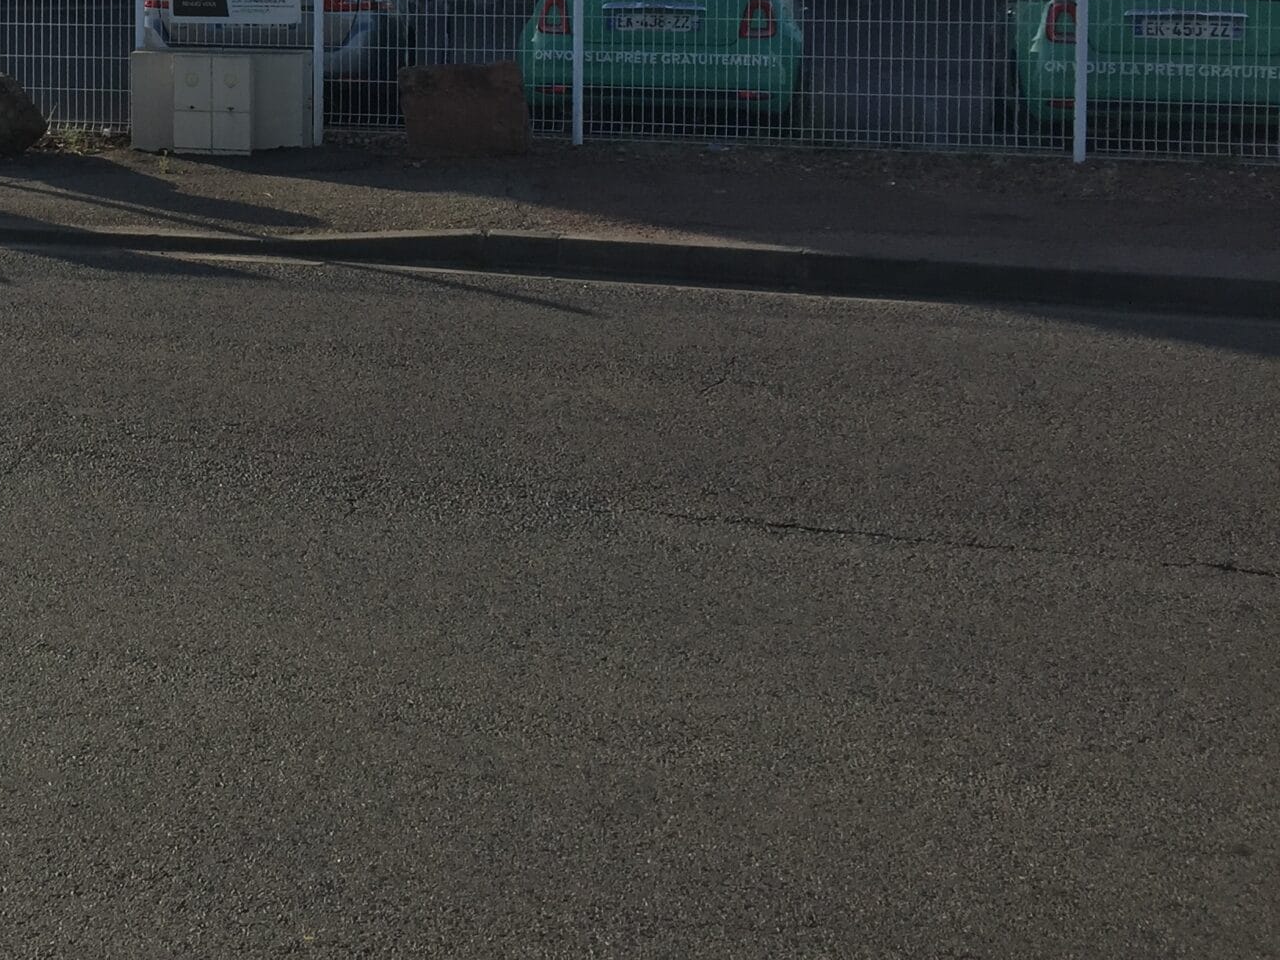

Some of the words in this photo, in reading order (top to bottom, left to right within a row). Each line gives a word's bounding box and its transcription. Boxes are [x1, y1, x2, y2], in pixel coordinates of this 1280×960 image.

[535, 49, 552, 60] ON
[556, 50, 592, 62] VOS
[596, 51, 612, 63] LA
[616, 49, 657, 64] PRÊTE
[1044, 61, 1066, 72] ON
[1121, 63, 1141, 75] LA
[1145, 60, 1194, 77] PRÊTE
